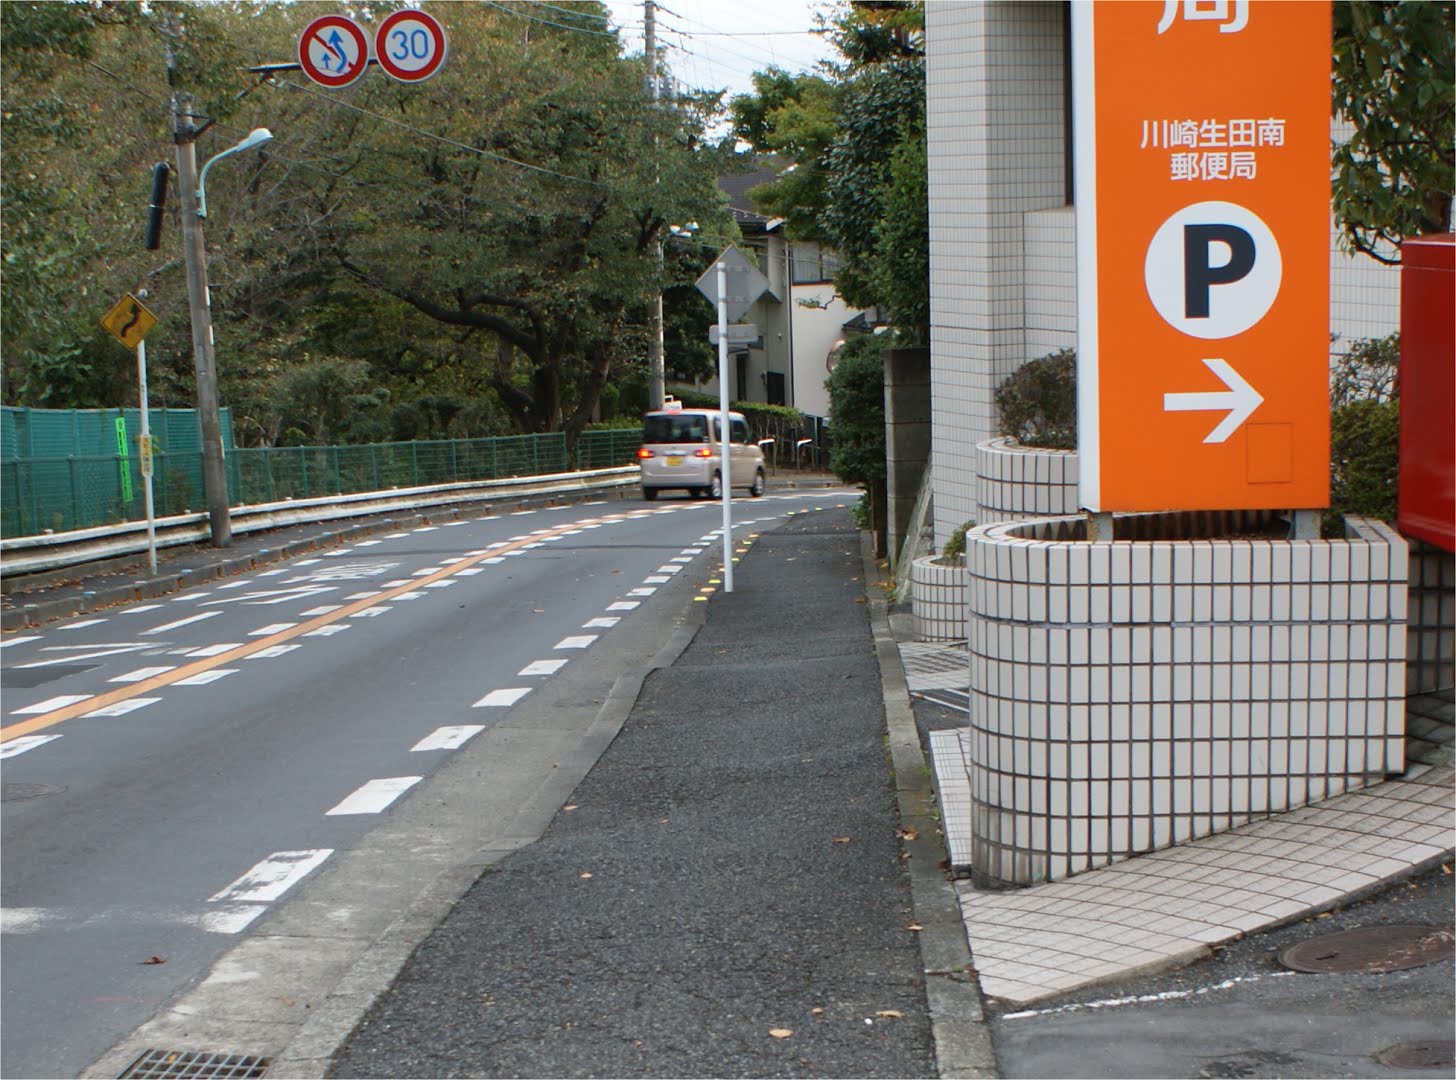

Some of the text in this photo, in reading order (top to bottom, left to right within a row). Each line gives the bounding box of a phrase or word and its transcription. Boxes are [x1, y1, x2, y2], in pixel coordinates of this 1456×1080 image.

[392, 29, 429, 60] 30
[1141, 118, 1286, 149] 川崎生田南
[1170, 151, 1257, 181] 郵便局
[1183, 223, 1256, 319] P
